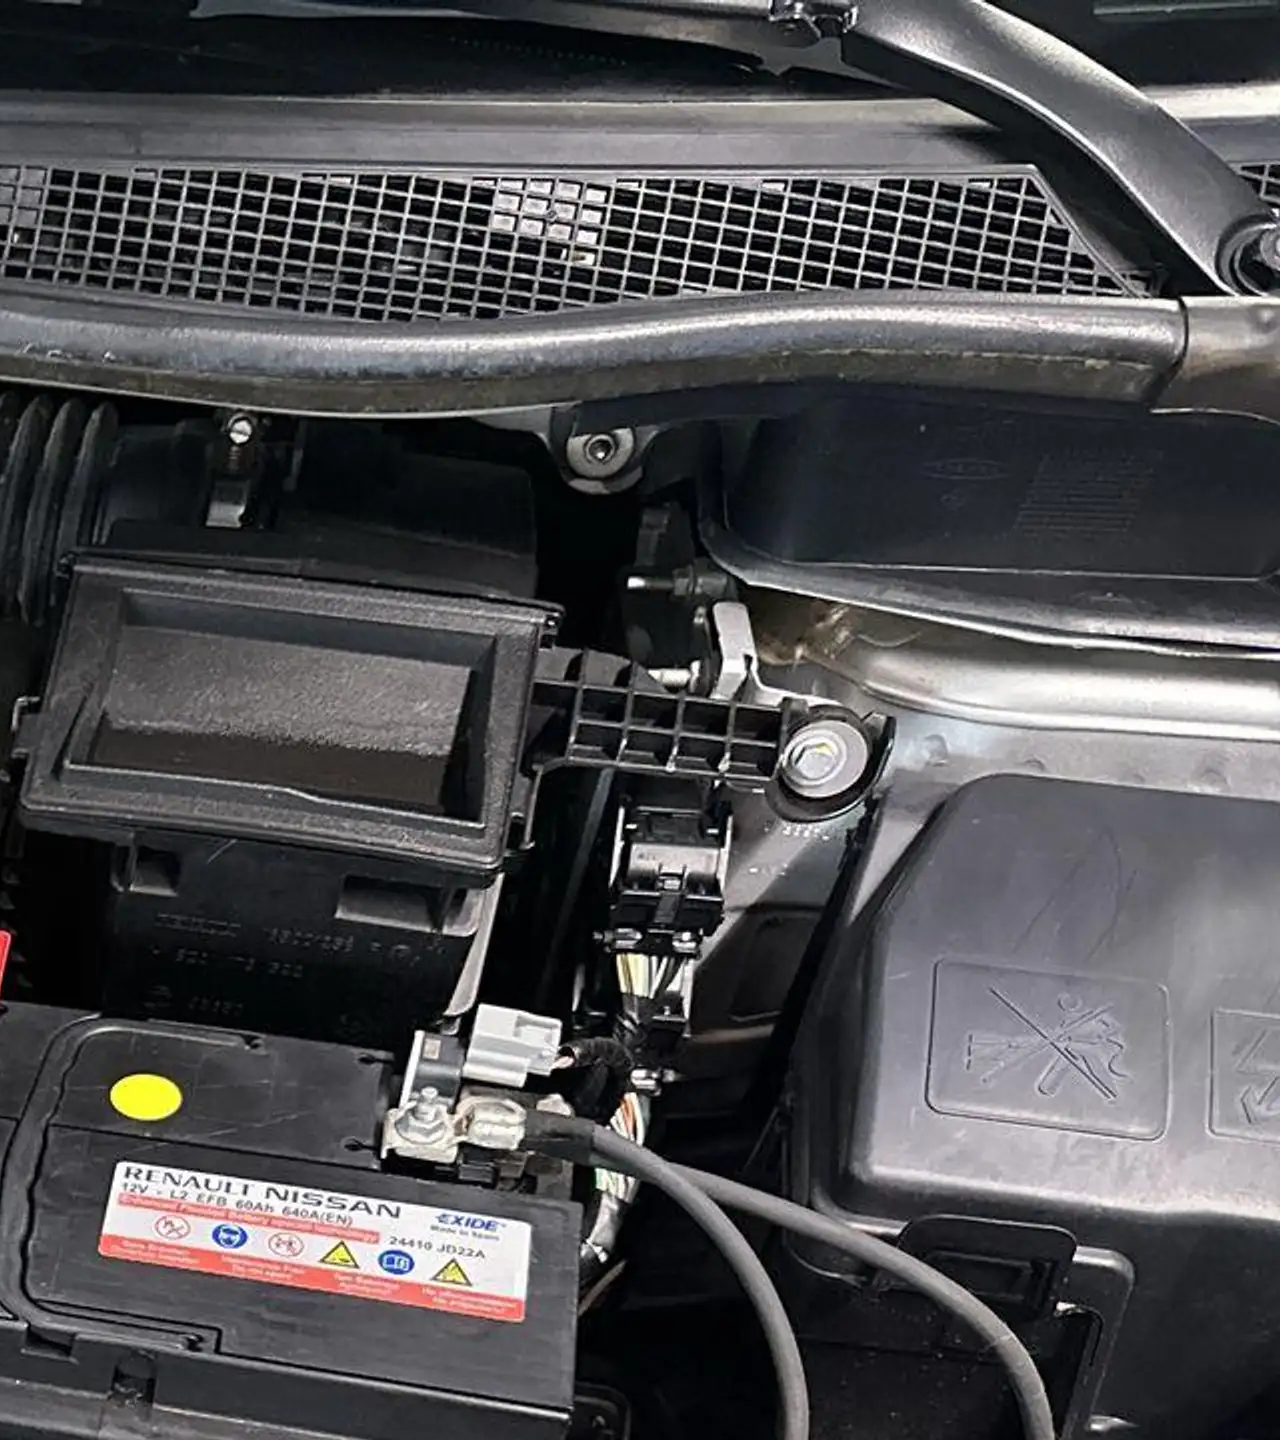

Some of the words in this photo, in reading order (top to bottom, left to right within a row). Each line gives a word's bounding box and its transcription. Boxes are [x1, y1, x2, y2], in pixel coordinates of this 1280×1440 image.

[121, 1181, 149, 1194] 12V
[169, 1189, 188, 1201] L2
[196, 1193, 228, 1206] EFB
[235, 1199, 275, 1214] 60Ah
[124, 1165, 256, 1196] RENAULT
[264, 1186, 402, 1219] NISSAN
[435, 1213, 500, 1232] EXIDE
